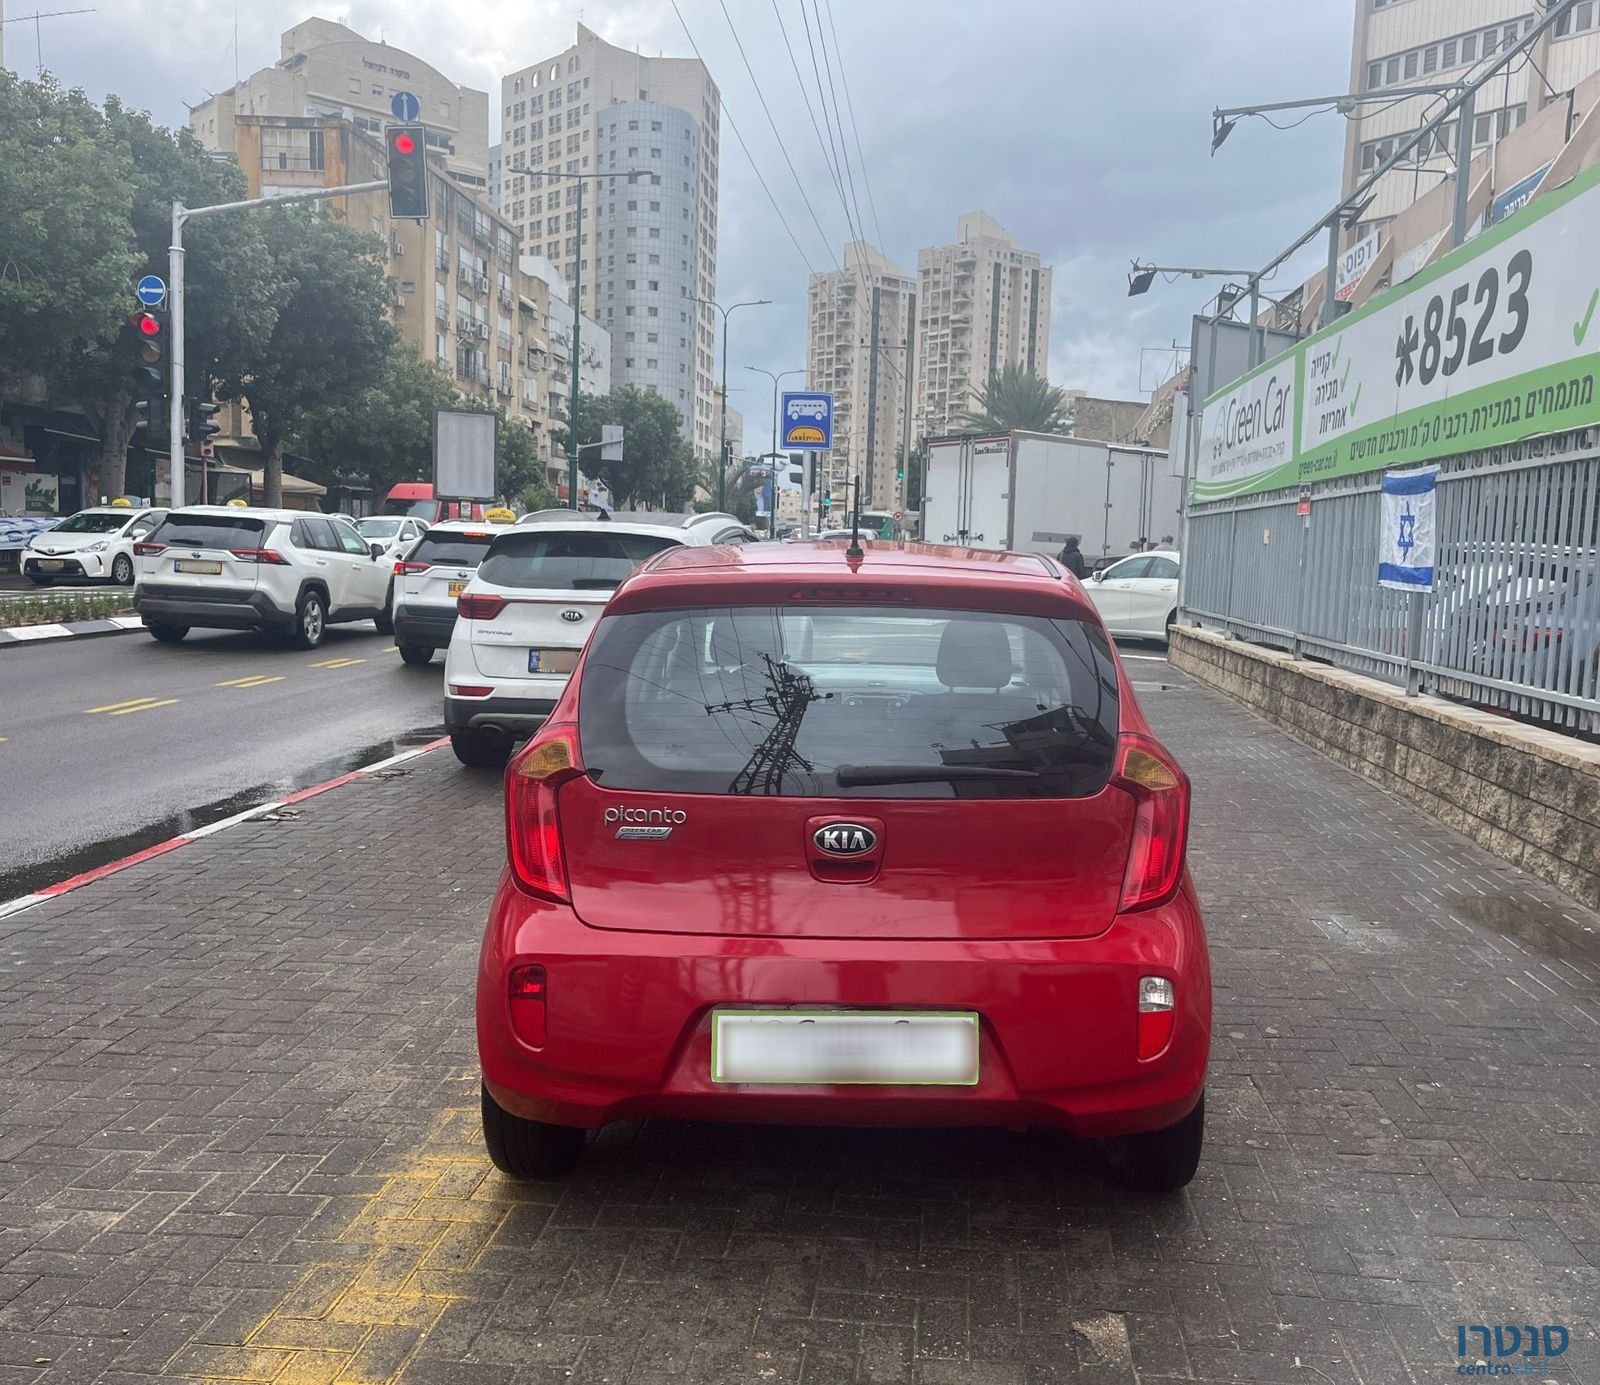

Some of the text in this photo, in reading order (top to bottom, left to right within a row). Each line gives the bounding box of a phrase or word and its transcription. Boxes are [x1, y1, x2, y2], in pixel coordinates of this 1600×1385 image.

[1346, 240, 1373, 273] דפוס
[1314, 379, 1338, 406] מכירה
[1525, 374, 1594, 419] מתמחים
[1226, 375, 1291, 450] Green Car
[1319, 405, 1348, 435] אחריות
[1444, 412, 1467, 440] רכבי
[1469, 395, 1521, 434] במכירת
[1378, 429, 1408, 453] ורכבים
[1432, 415, 1440, 443] 0
[1349, 436, 1378, 461] חדשים
[1298, 449, 1339, 480] green-car.co.il
[564, 611, 581, 620] KIA
[604, 805, 687, 826] picanto
[823, 830, 867, 849] KIA
